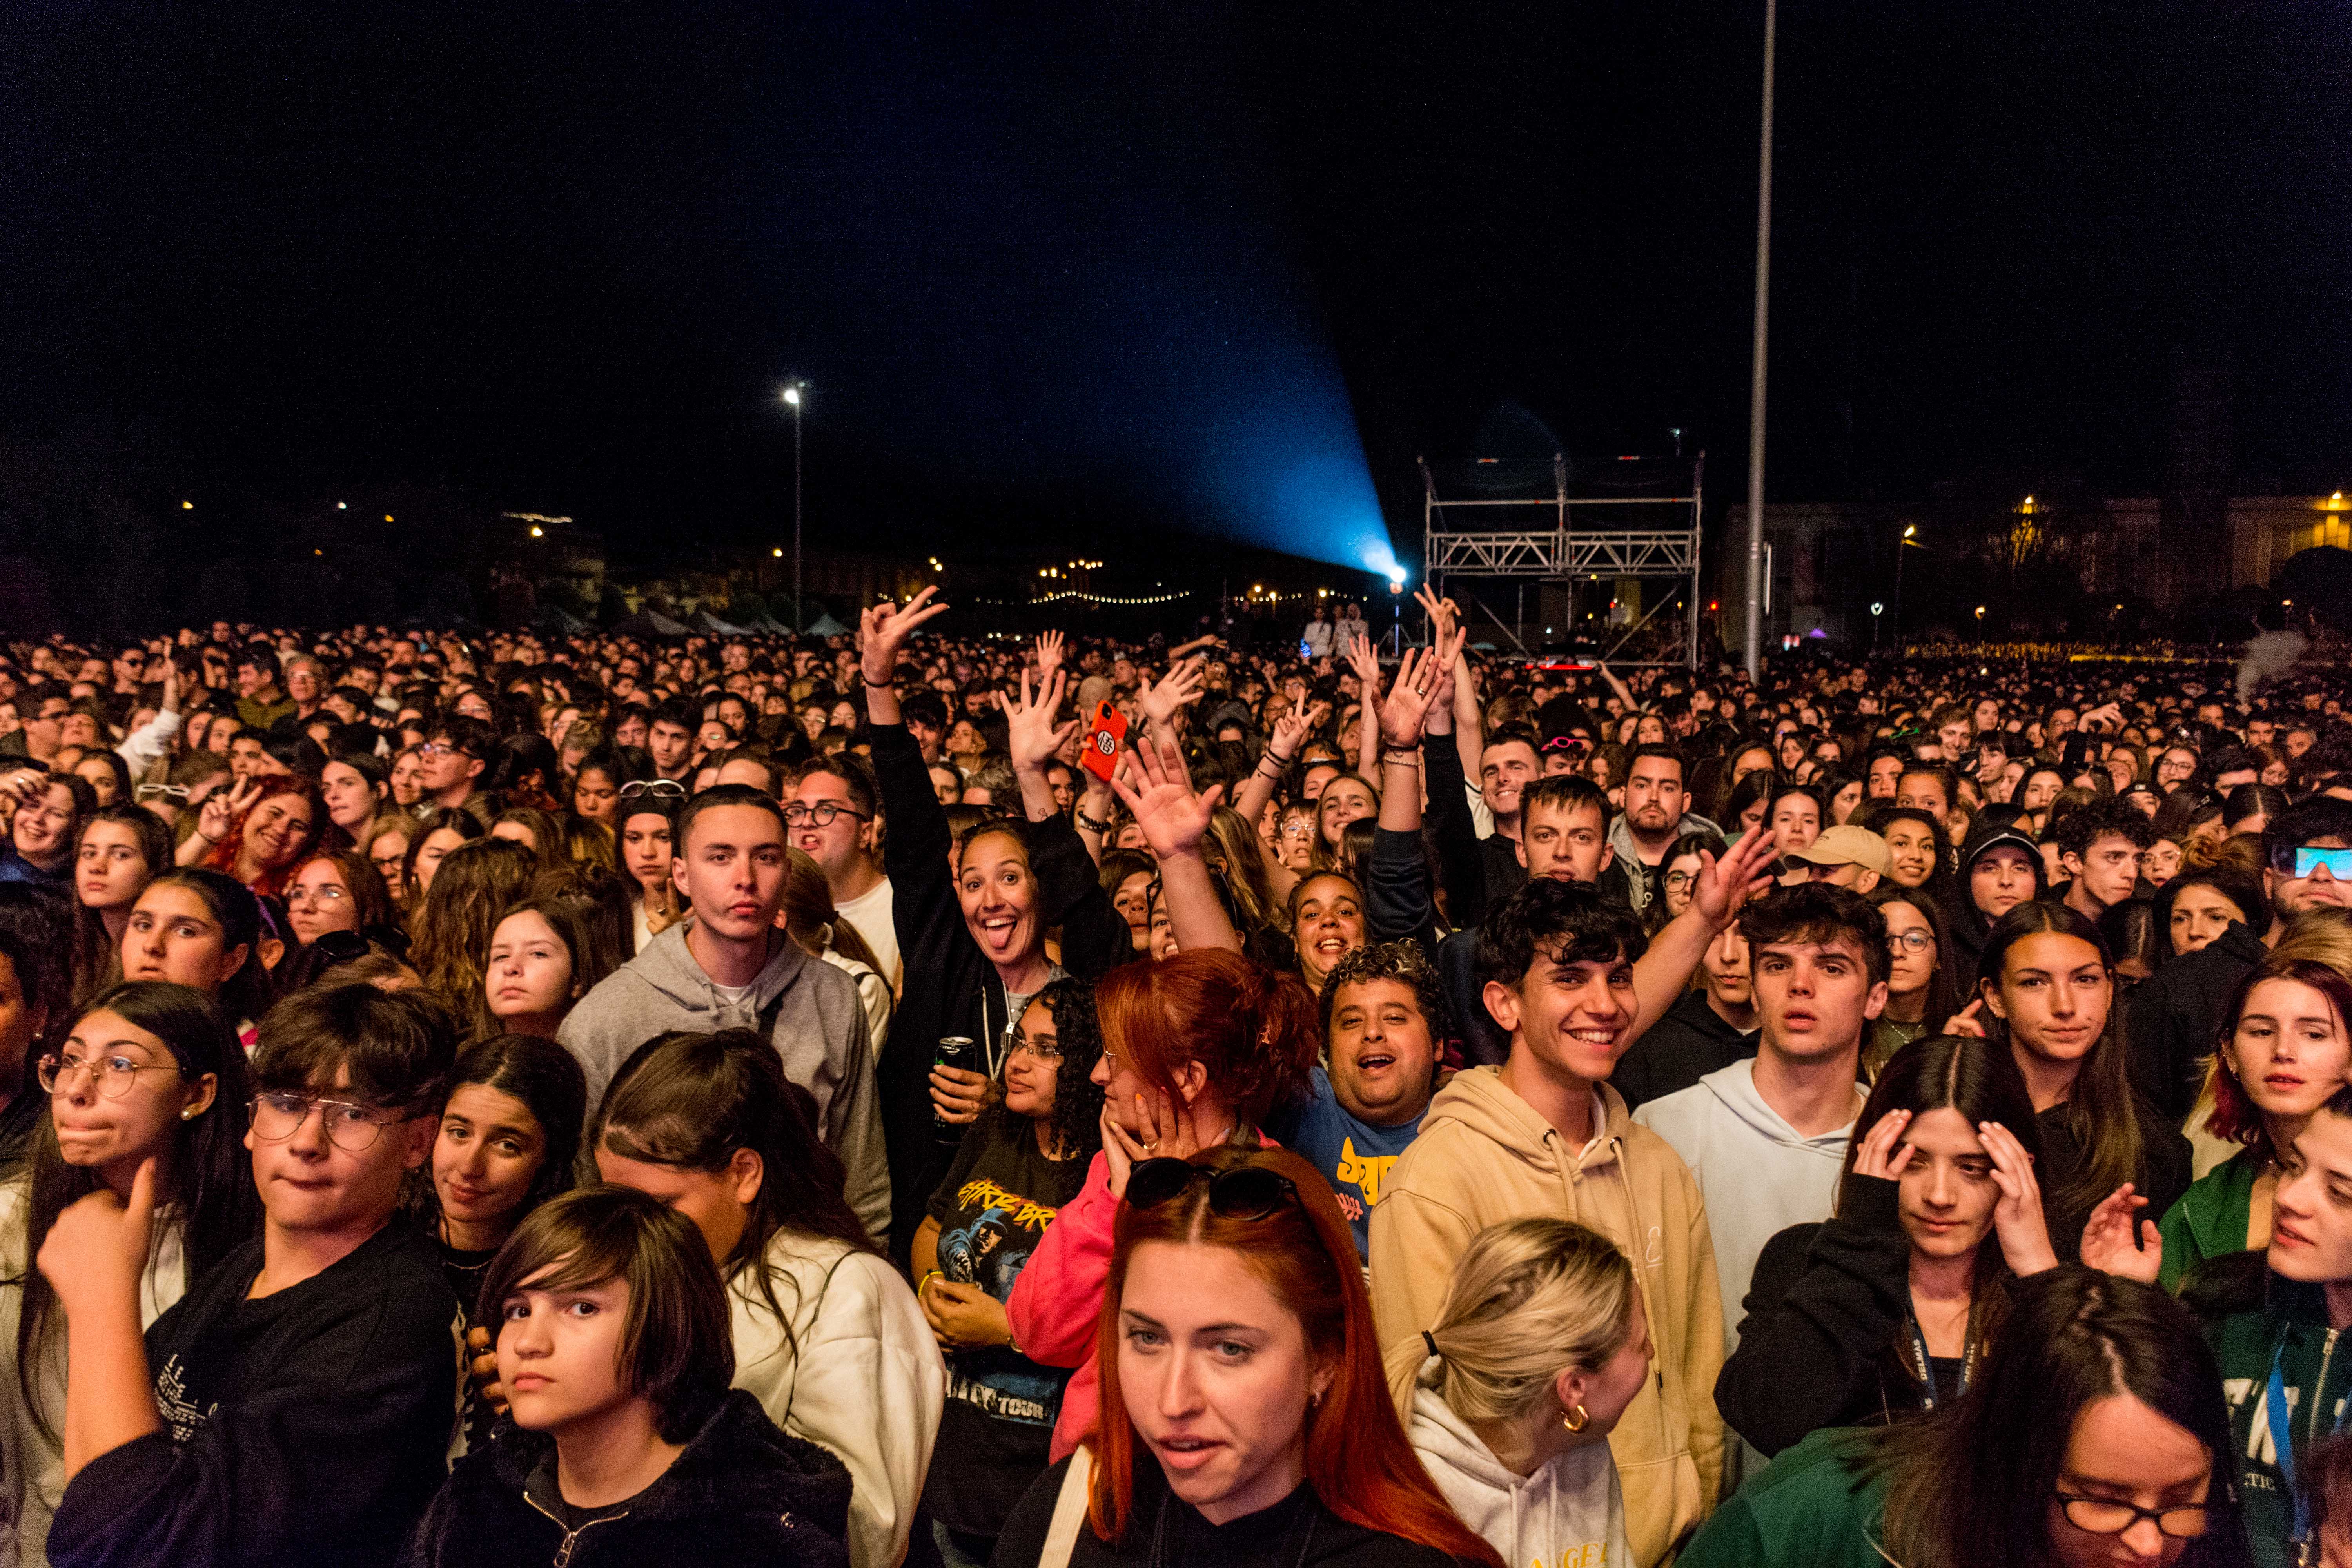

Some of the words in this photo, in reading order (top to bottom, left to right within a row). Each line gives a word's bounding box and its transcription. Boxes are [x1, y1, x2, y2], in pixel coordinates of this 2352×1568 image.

[1098, 733, 1114, 753] 悟
[1013, 1203, 1057, 1233] BR
[998, 1397, 1044, 1420] TOUR
